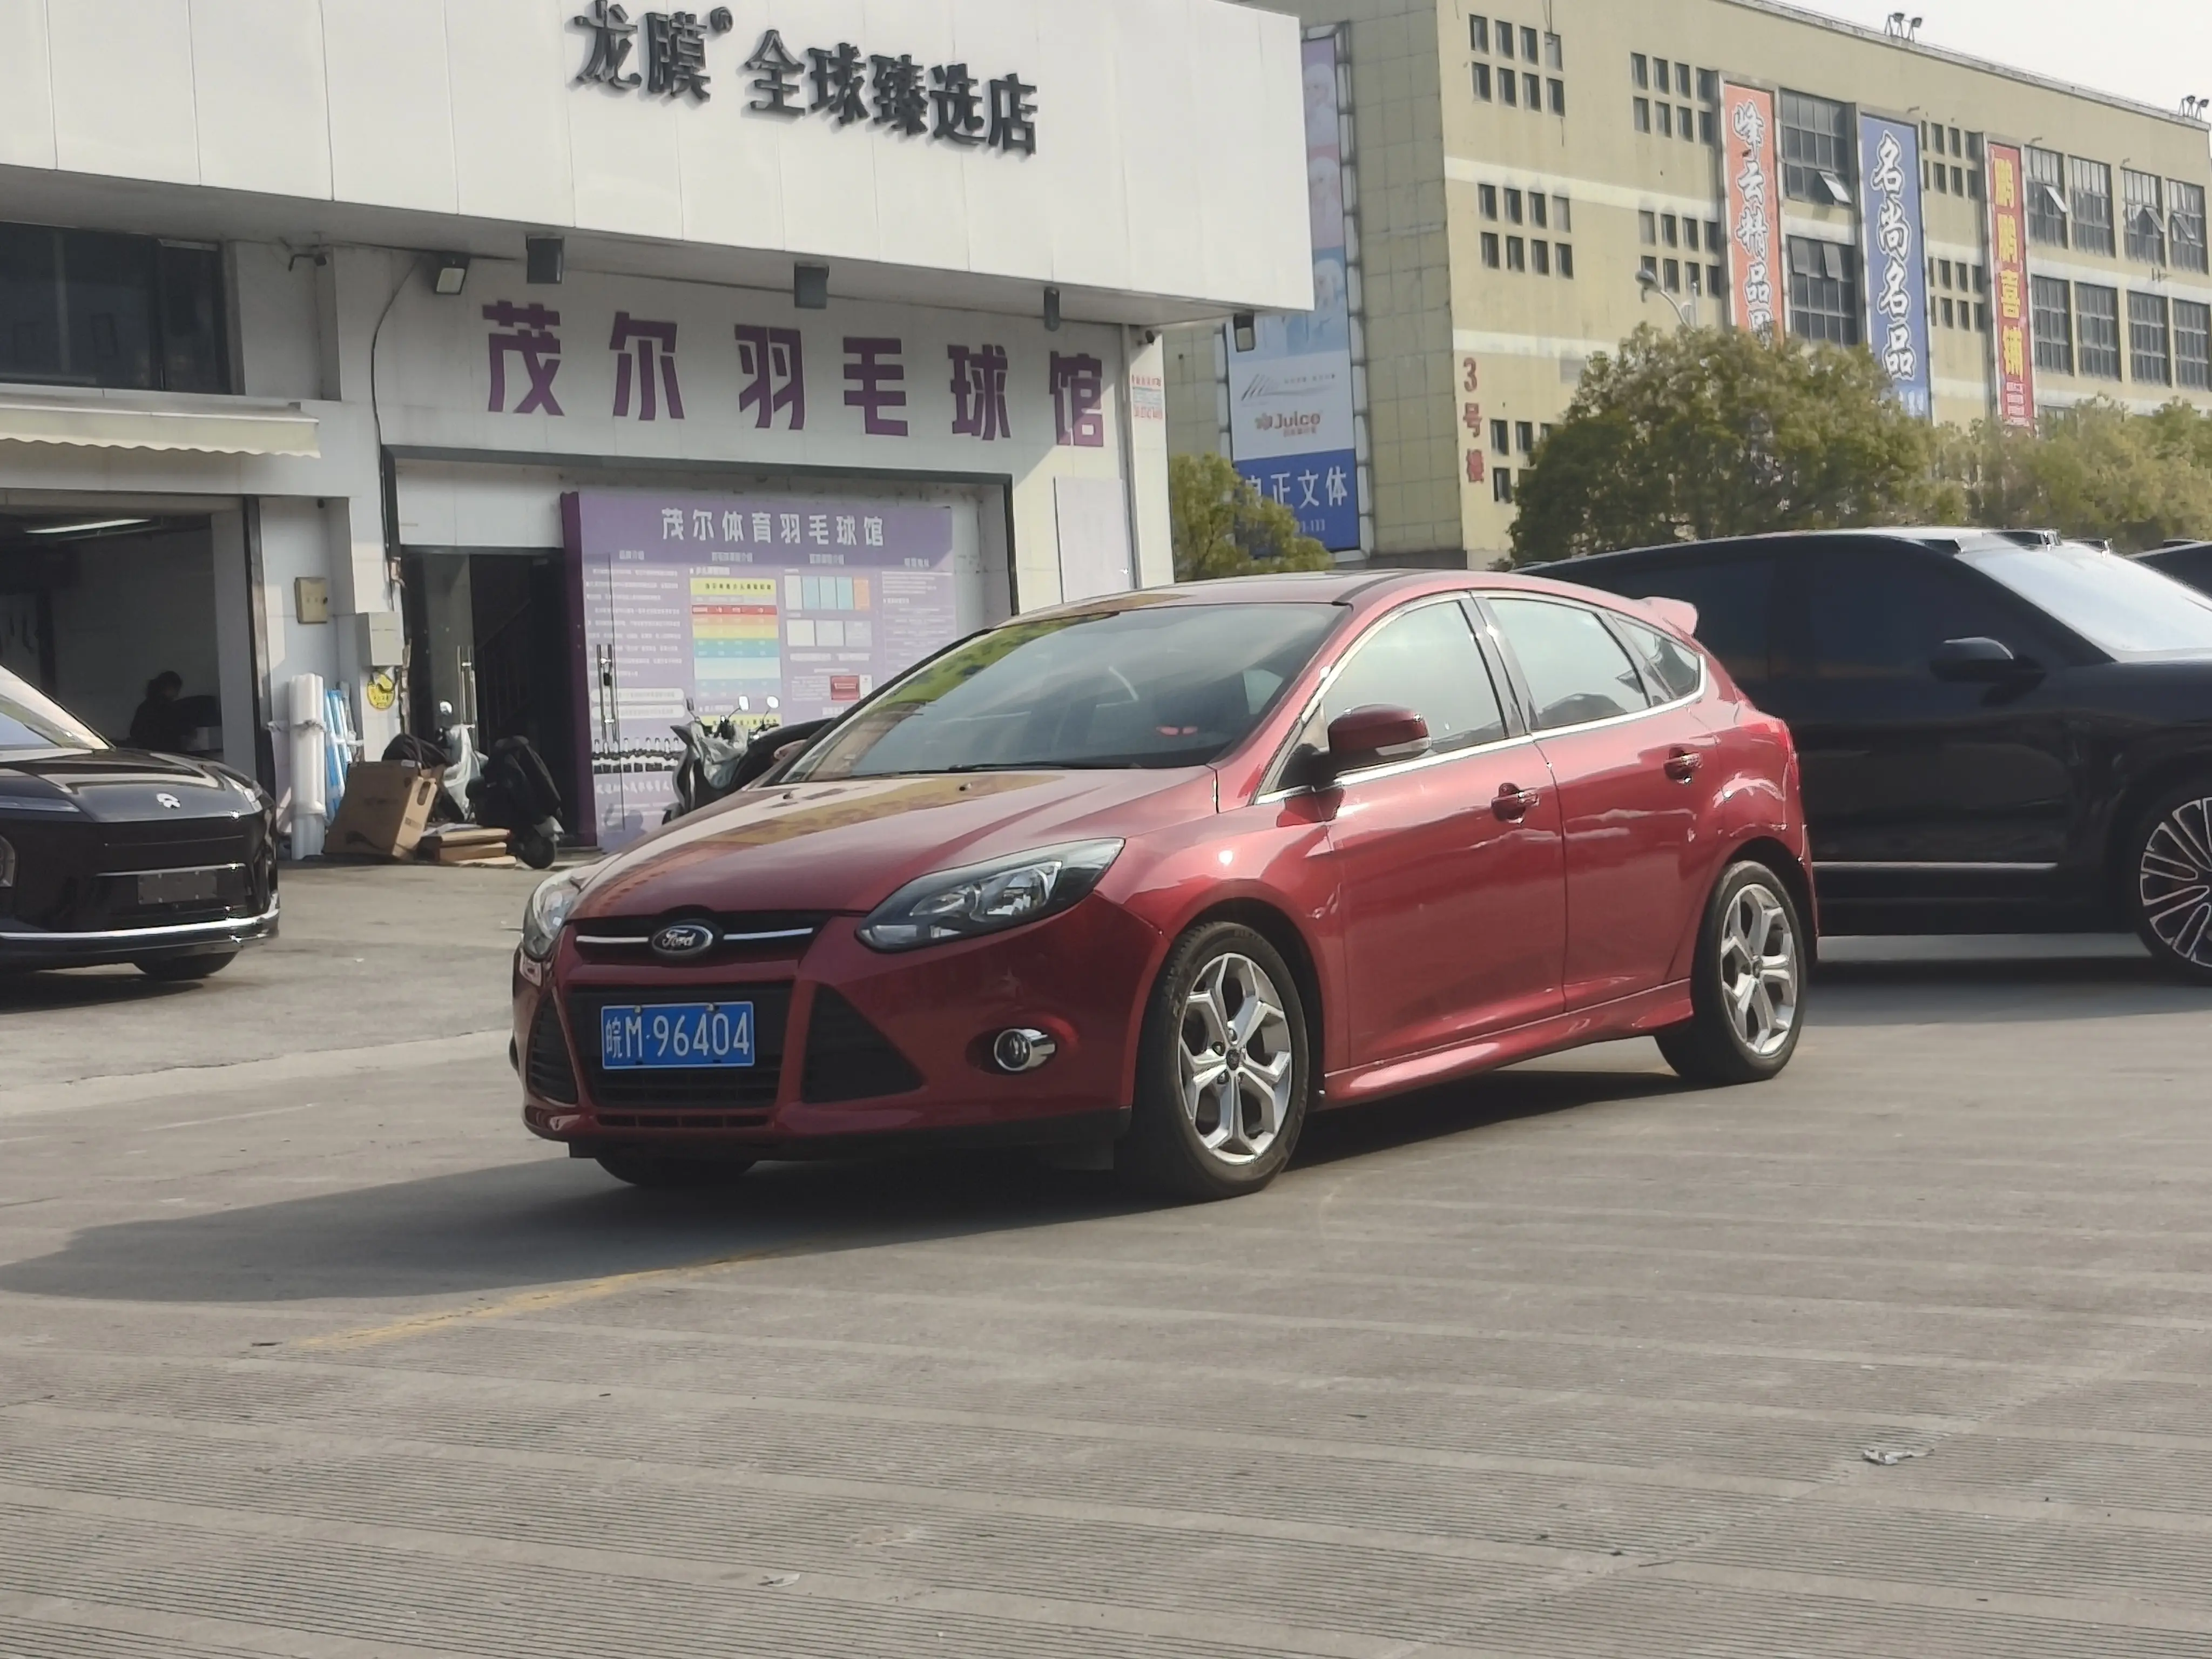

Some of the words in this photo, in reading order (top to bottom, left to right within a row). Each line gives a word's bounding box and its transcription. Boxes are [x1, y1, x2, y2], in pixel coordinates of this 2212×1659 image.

[743, 29, 1038, 156] 全球臻选店
[1872, 130, 1917, 381] 名尚名品
[482, 300, 1104, 448] 茂尔羽毛球馆
[661, 507, 885, 547] 茂尔体育羽毛球馆
[662, 928, 696, 947] Ford
